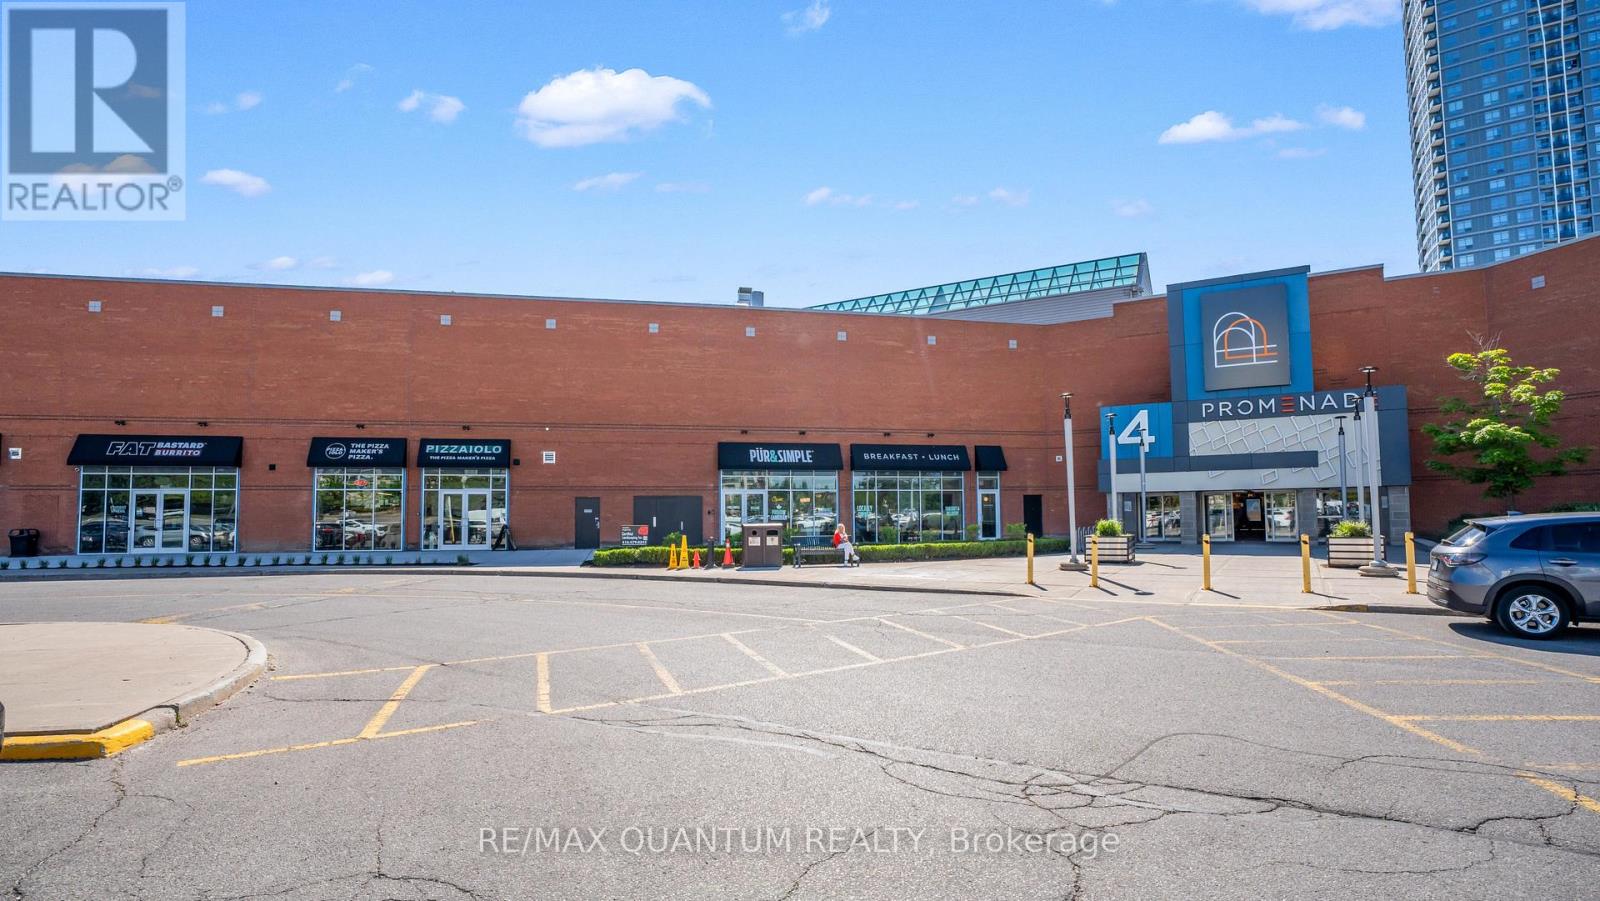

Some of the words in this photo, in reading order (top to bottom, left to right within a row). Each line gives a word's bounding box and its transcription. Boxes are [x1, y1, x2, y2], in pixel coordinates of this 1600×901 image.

[1202, 391, 1378, 418] PROMENAD
[1117, 409, 1156, 453] 4
[106, 441, 157, 456] FAT
[425, 444, 502, 454] PIZZAIOLO
[863, 452, 918, 460] BREAKFAST
[928, 454, 960, 462] LUNCH
